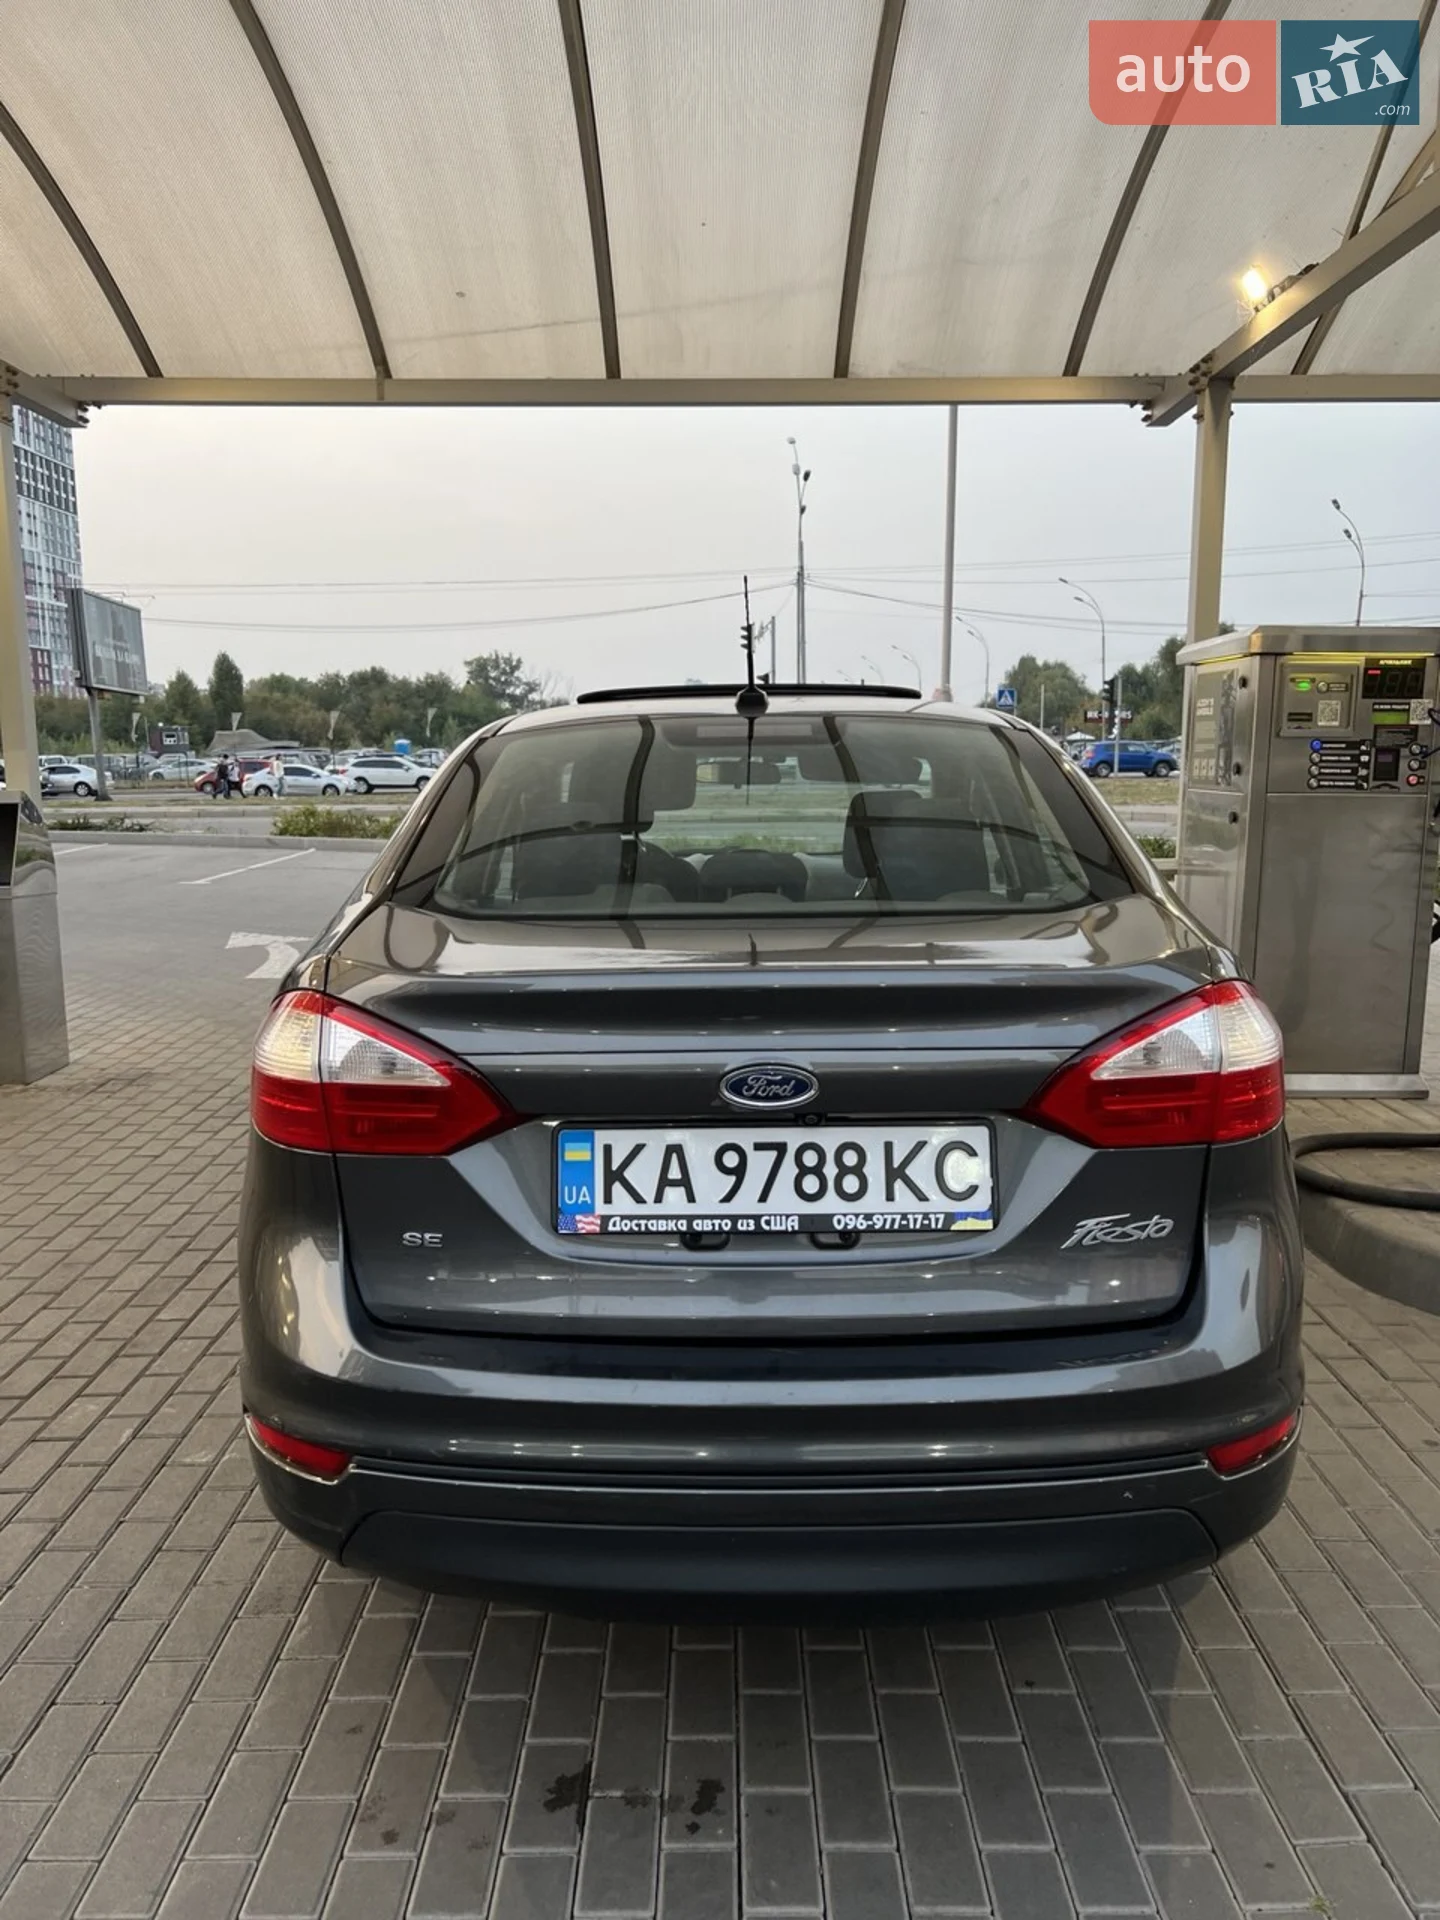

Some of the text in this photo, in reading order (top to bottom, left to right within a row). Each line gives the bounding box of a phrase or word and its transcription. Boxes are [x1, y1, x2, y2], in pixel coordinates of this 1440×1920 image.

[742, 1074, 796, 1097] Ford
[602, 1139, 980, 1205] KA 9788 KC
[564, 1185, 592, 1205] UA
[607, 1215, 799, 1232] Доставка авто из США
[832, 1214, 945, 1230] 096-977-17-17
[1060, 1213, 1174, 1249] Fiesta
[402, 1232, 443, 1247] SE
